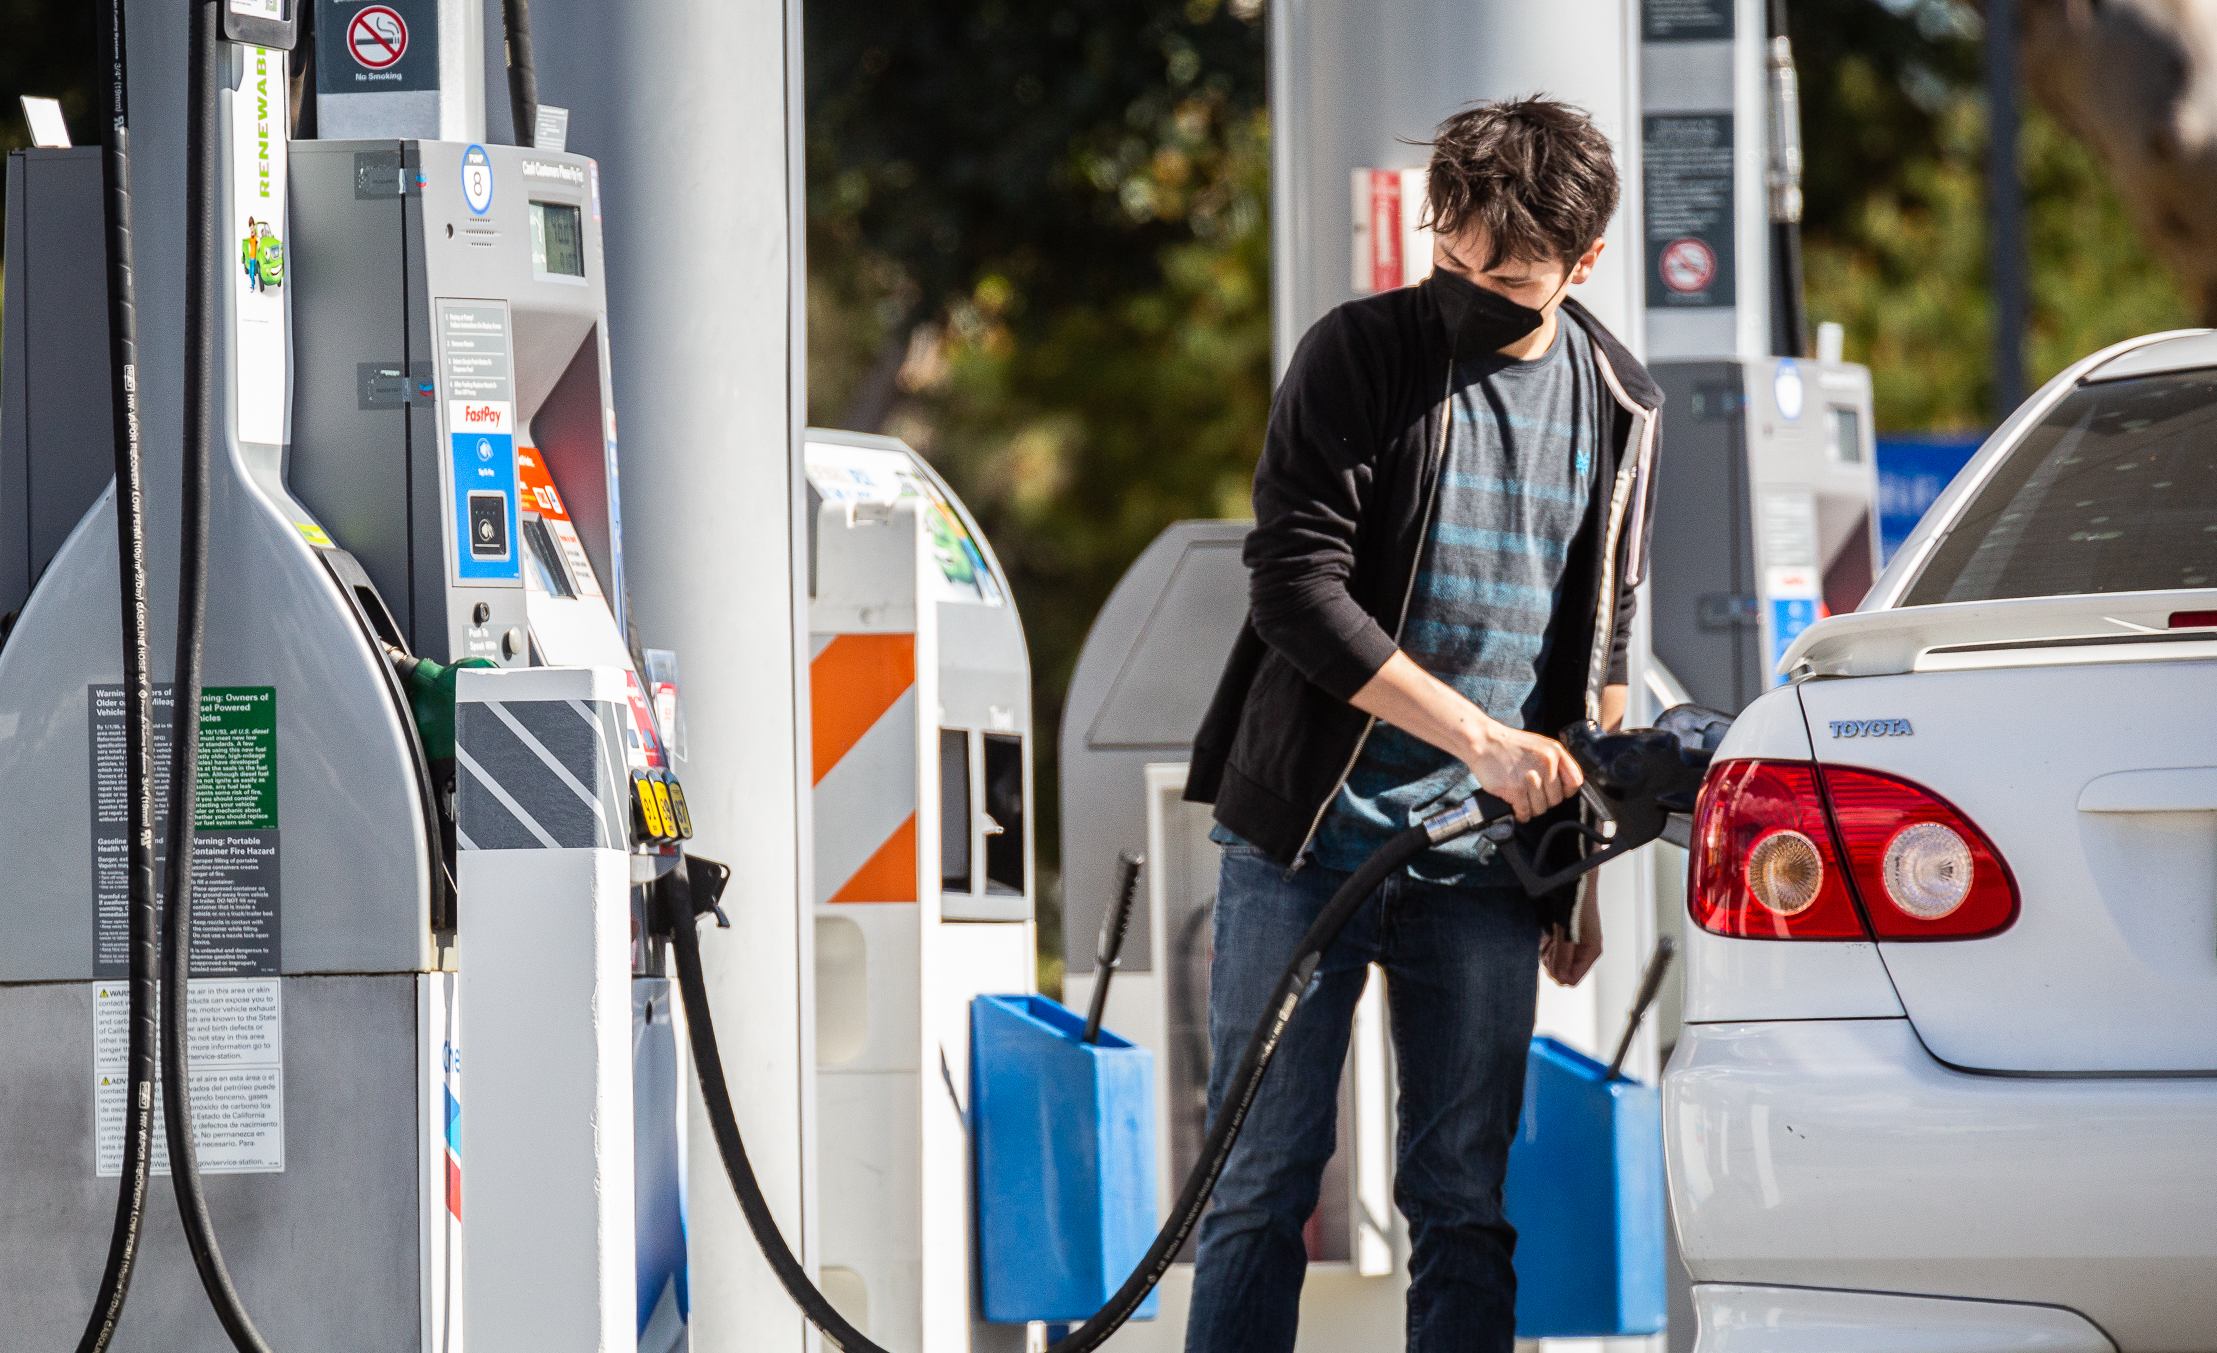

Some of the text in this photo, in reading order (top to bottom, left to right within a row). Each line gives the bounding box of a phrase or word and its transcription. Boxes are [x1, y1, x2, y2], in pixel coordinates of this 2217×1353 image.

[368, 72, 402, 81] Smoking
[473, 171, 482, 196] 8
[465, 405, 501, 428] FastPay
[130, 442, 139, 490] RECOVERY
[132, 492, 140, 513] LOW
[133, 514, 141, 539] PERM
[136, 602, 145, 645] GASOLINE
[468, 628, 489, 638] Push To
[469, 640, 497, 652] Speak With
[138, 647, 146, 672] HOSE
[139, 674, 146, 685] BY
[96, 698, 117, 706] Older
[200, 692, 269, 703] rning: Owners of
[200, 703, 251, 712] sel Powered
[200, 714, 222, 722] hicles
[1829, 719, 1914, 738] TOYOTA
[643, 798, 657, 820] 91
[660, 798, 673, 821] 89
[675, 800, 688, 823] 87
[97, 837, 127, 845] Gasoline
[226, 837, 261, 845] Portable
[97, 845, 120, 853] Health
[229, 847, 245, 855] Fire
[246, 847, 275, 855] Hazard
[210, 1034, 225, 1042] stay
[210, 1042, 251, 1050] information
[232, 1111, 266, 1119] California
[132, 1162, 145, 1210] RECOVERY
[128, 1211, 138, 1231] LOW
[123, 1233, 135, 1259] PERM
